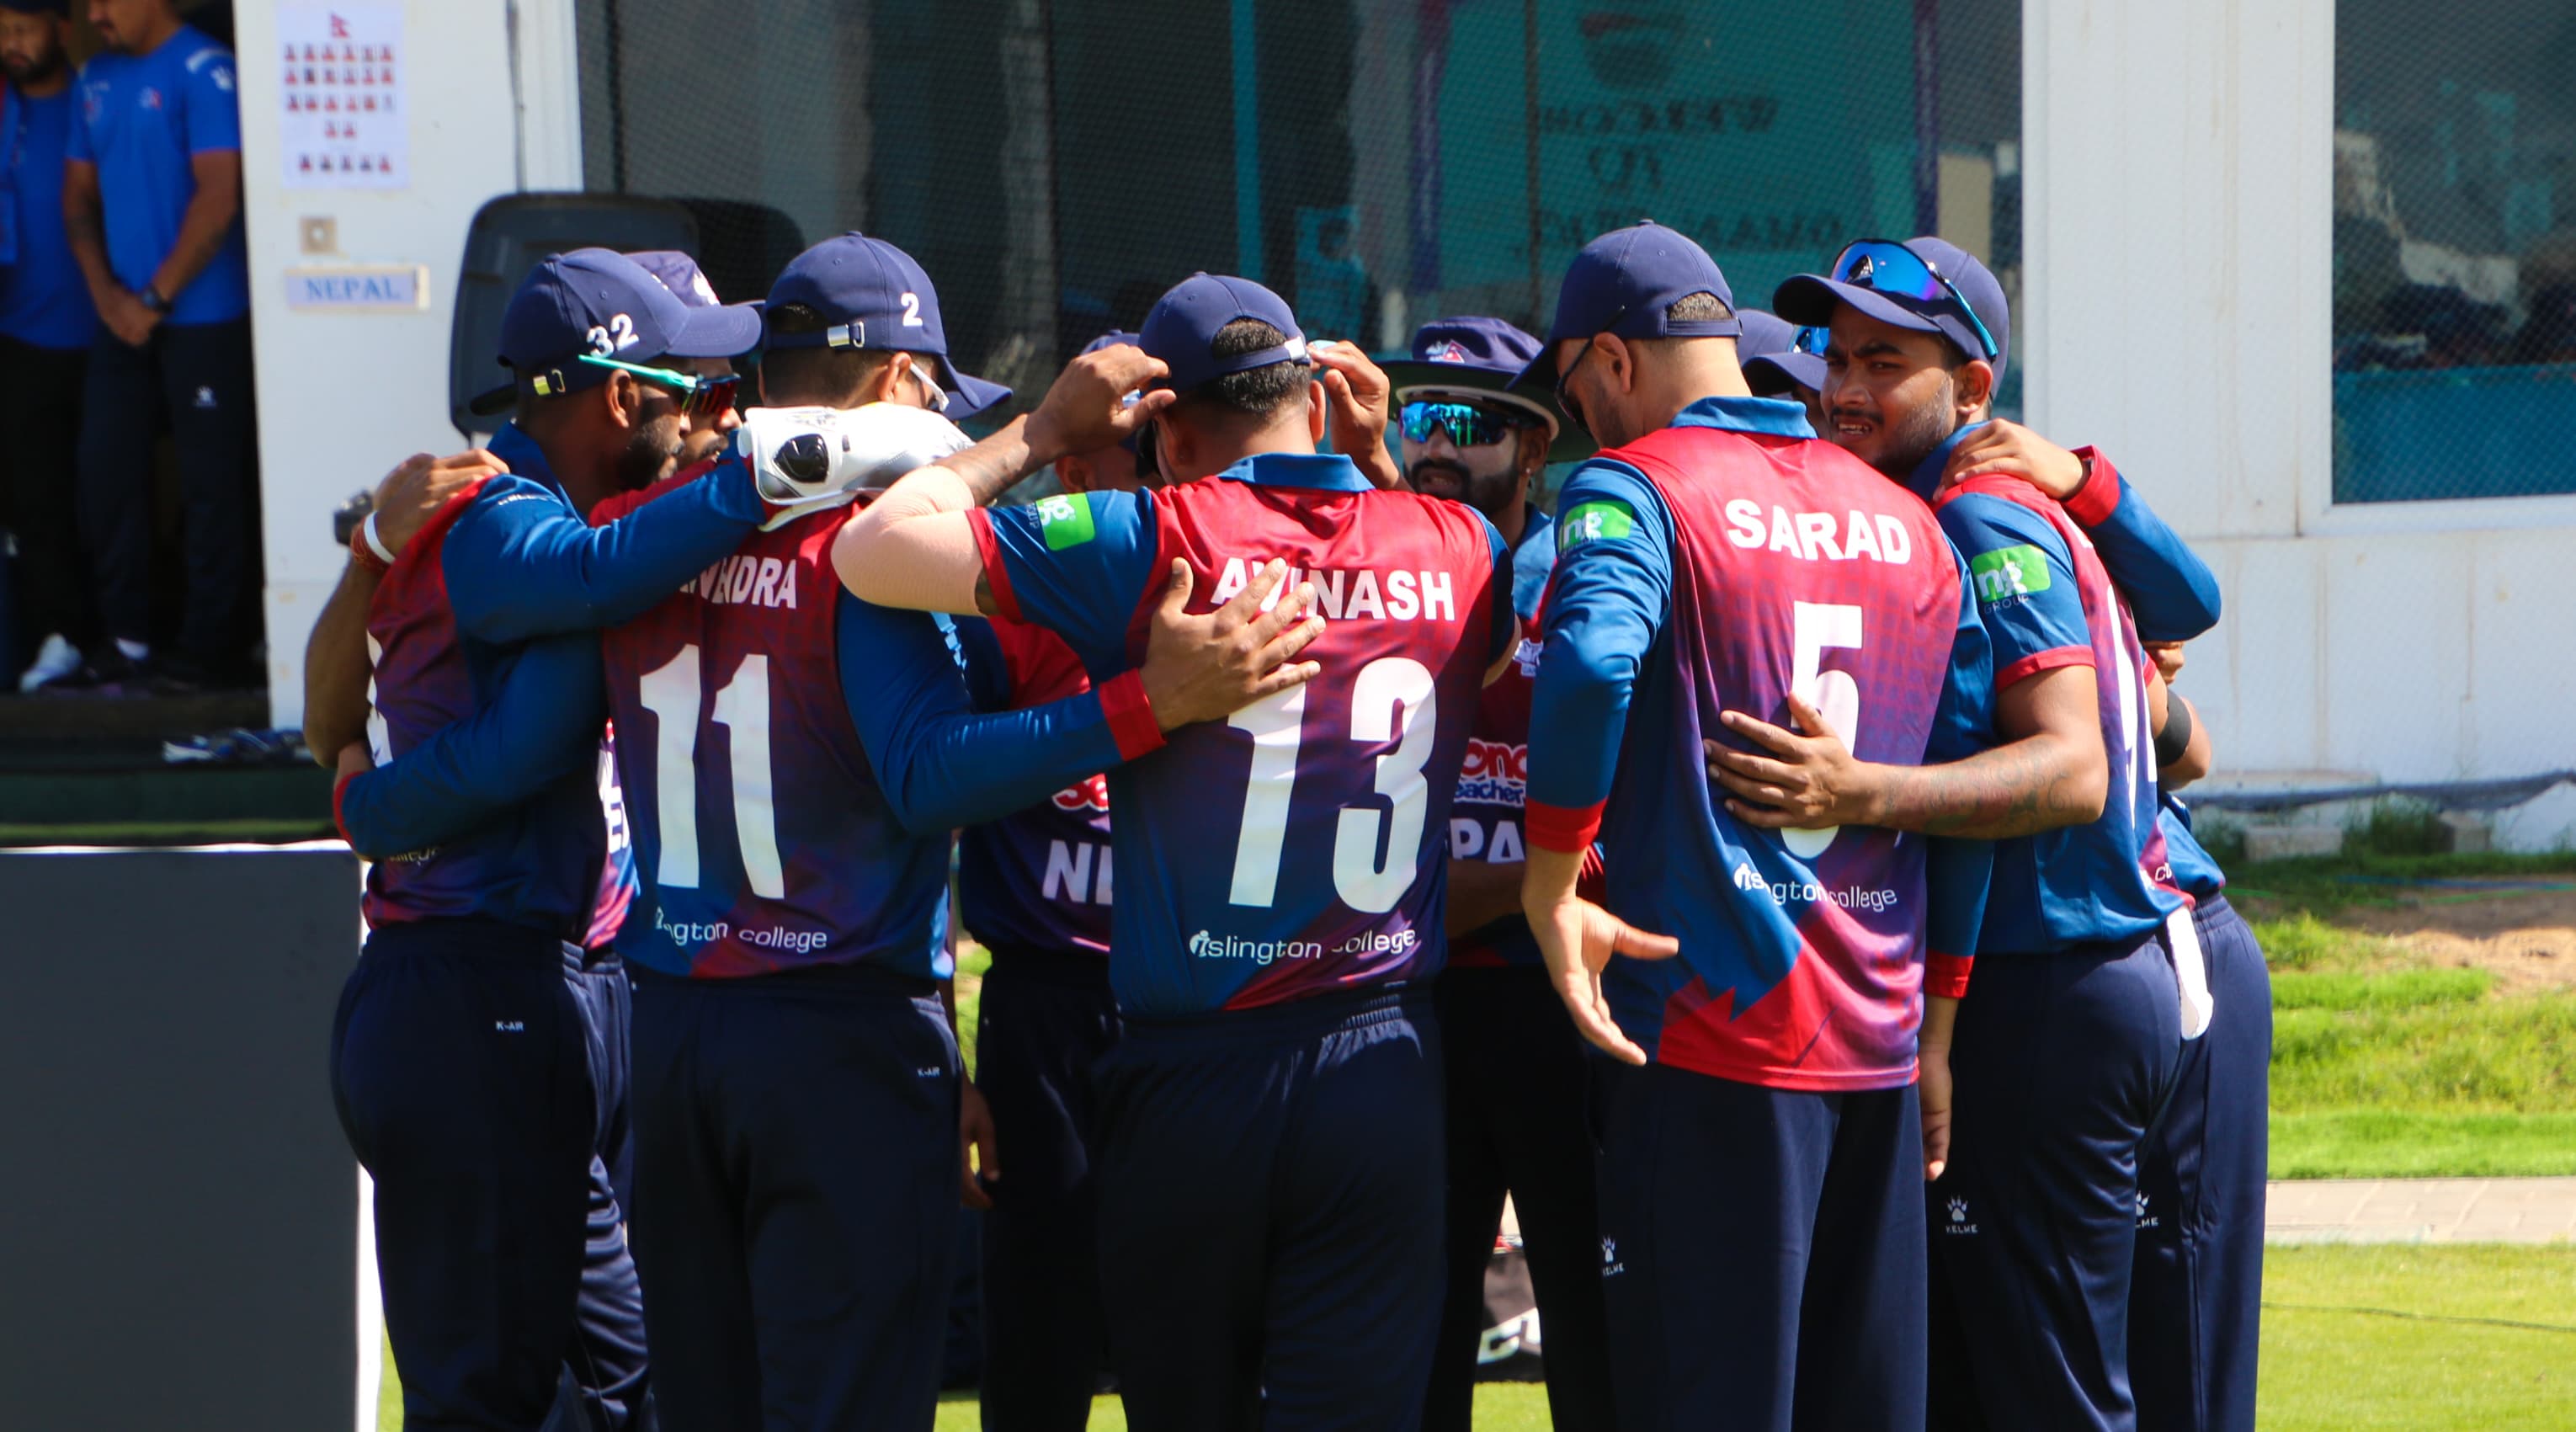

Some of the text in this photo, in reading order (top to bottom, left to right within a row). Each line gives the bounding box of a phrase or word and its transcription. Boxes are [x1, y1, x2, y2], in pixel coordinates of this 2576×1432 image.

[306, 278, 400, 300] NEPAL
[901, 292, 923, 327] 2
[586, 312, 640, 359] 32
[1725, 498, 1912, 566] SARAD
[1983, 592, 2030, 615] GROUP
[1780, 600, 1863, 860] 5
[640, 642, 785, 900] 11
[1227, 657, 1437, 914] 13
[1445, 817, 1526, 864] PA
[1828, 886, 1897, 913] college
[738, 925, 828, 953] college
[1189, 929, 1322, 965] islington
[1945, 1224, 1979, 1235] KELME
